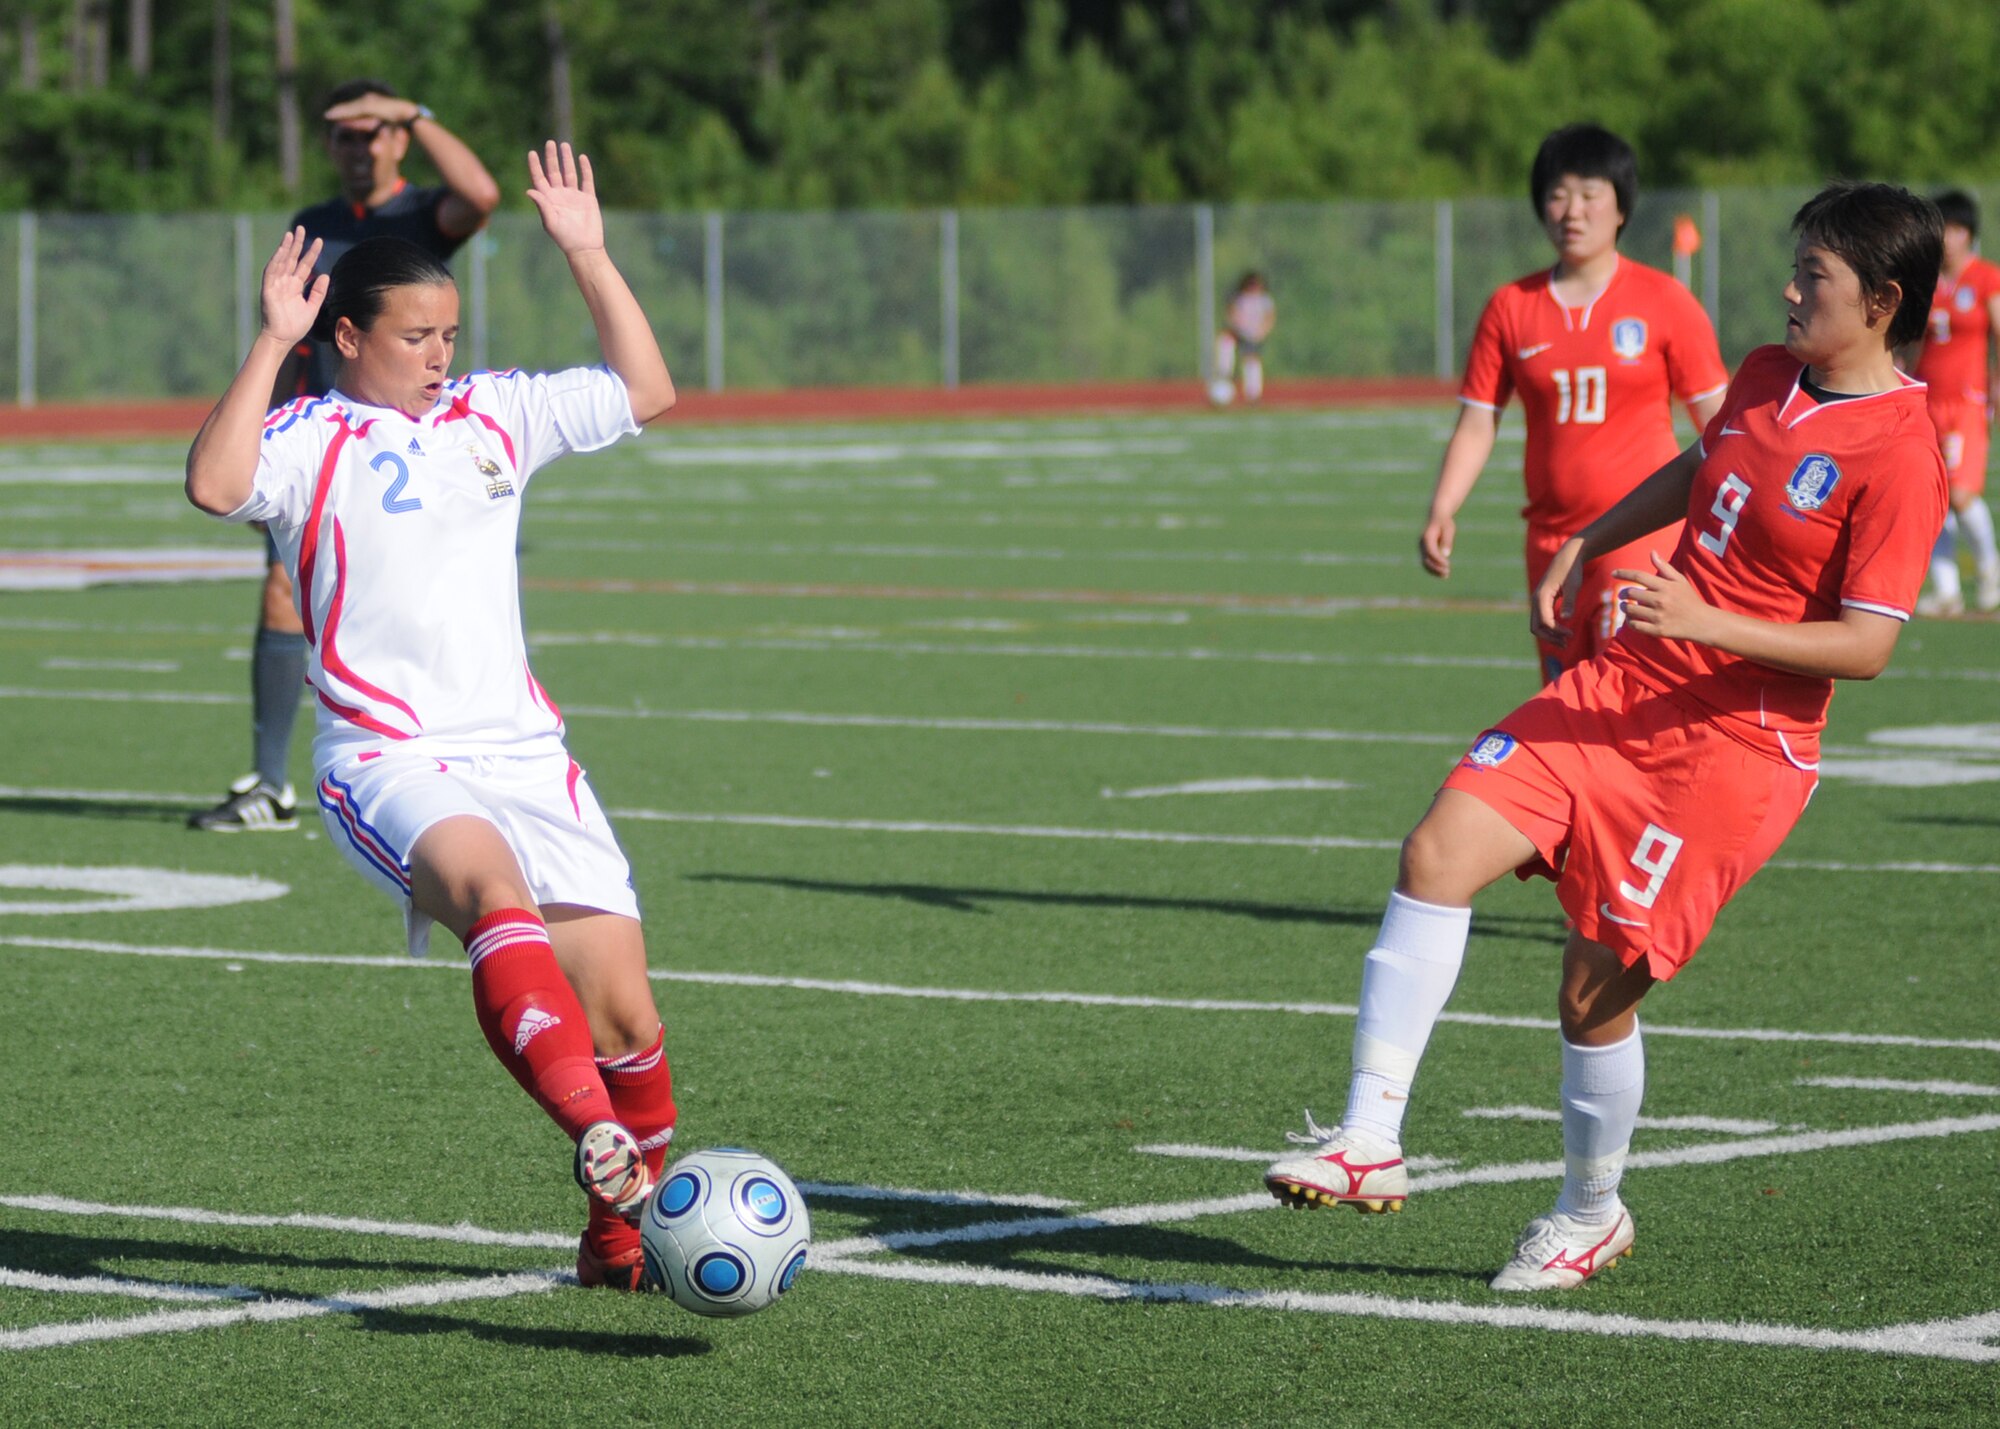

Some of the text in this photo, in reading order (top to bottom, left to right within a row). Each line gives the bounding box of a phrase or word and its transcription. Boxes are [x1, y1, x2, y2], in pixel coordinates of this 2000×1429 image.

[1552, 366, 1606, 424] 10
[369, 450, 423, 514] 2
[486, 480, 515, 499] FFF
[1698, 472, 1752, 558] 9
[1619, 822, 1684, 909] 9
[514, 1015, 561, 1055] adidas
